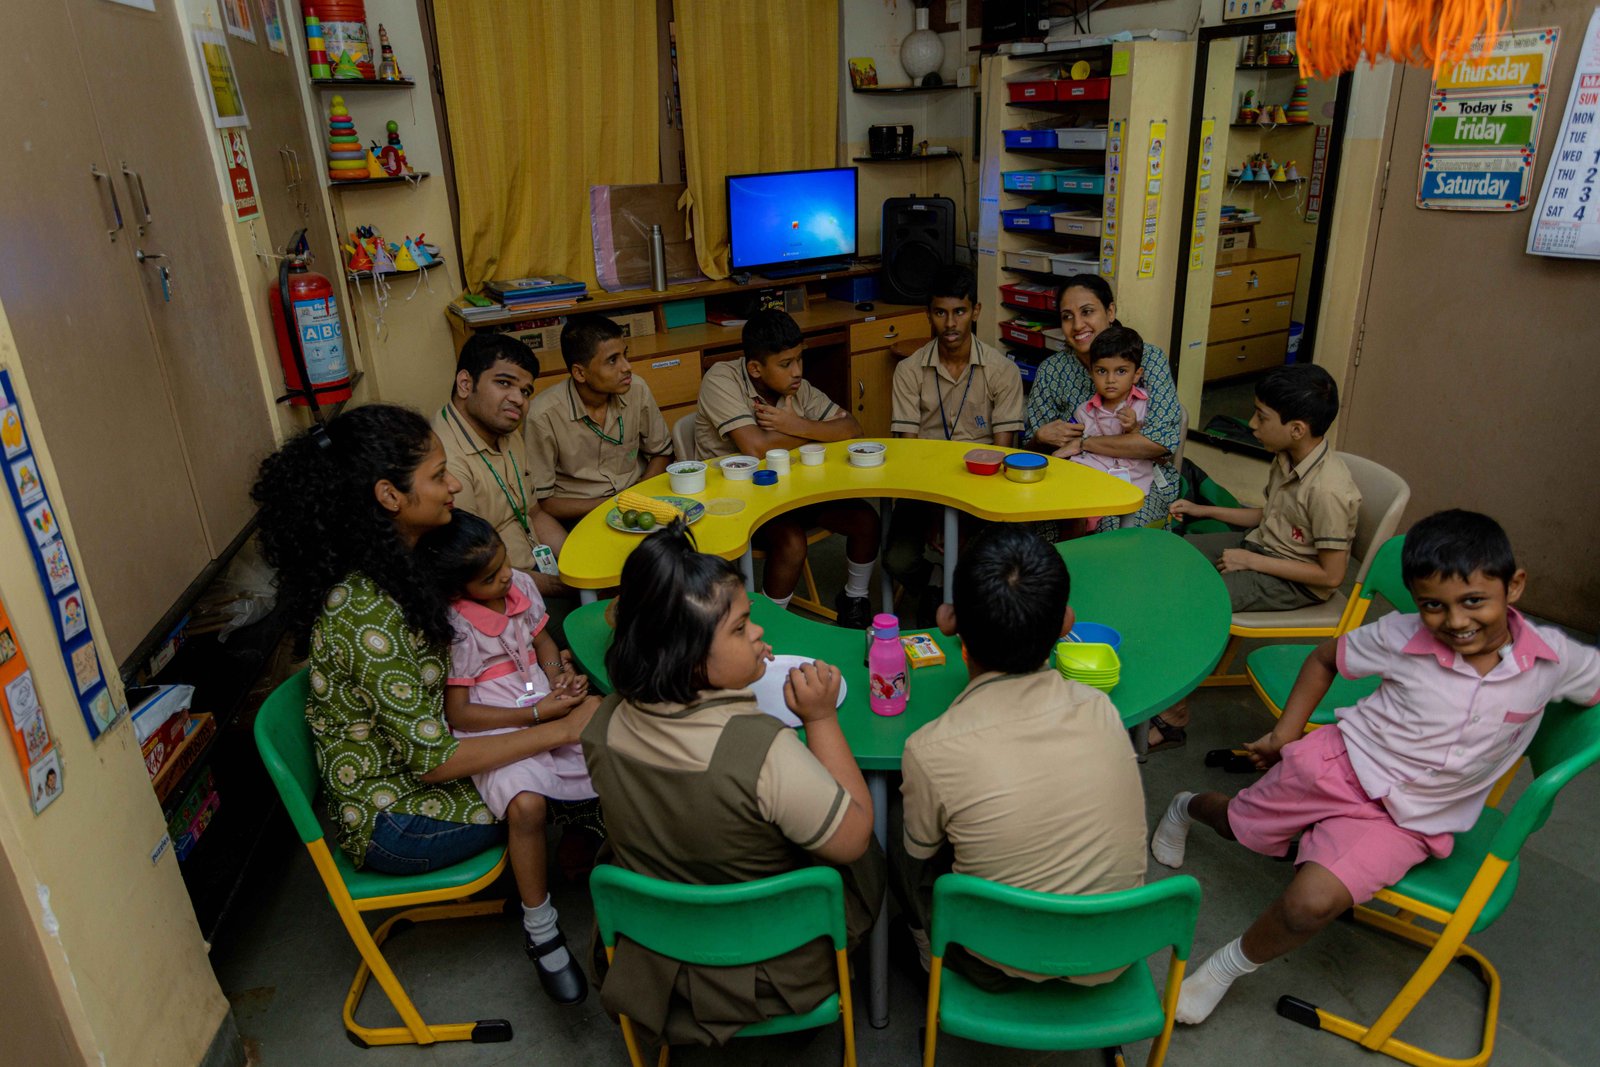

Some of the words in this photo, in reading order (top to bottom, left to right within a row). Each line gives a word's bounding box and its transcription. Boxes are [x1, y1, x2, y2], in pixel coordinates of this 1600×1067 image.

[1450, 56, 1530, 84] Thursday
[1578, 92, 1598, 105] SUN
[1458, 102, 1496, 115] Today
[1501, 100, 1513, 113] is
[1572, 112, 1595, 124] MON
[1454, 117, 1507, 144] Friday
[1569, 131, 1587, 143] TUE
[1562, 150, 1582, 162] WED
[1557, 168, 1576, 181] THU
[1584, 167, 1598, 184] 2
[1433, 172, 1510, 200] Saturday
[1552, 187, 1569, 199] FRI
[1579, 186, 1592, 203] 3
[1546, 205, 1564, 217] SAT
[1572, 205, 1586, 221] 4
